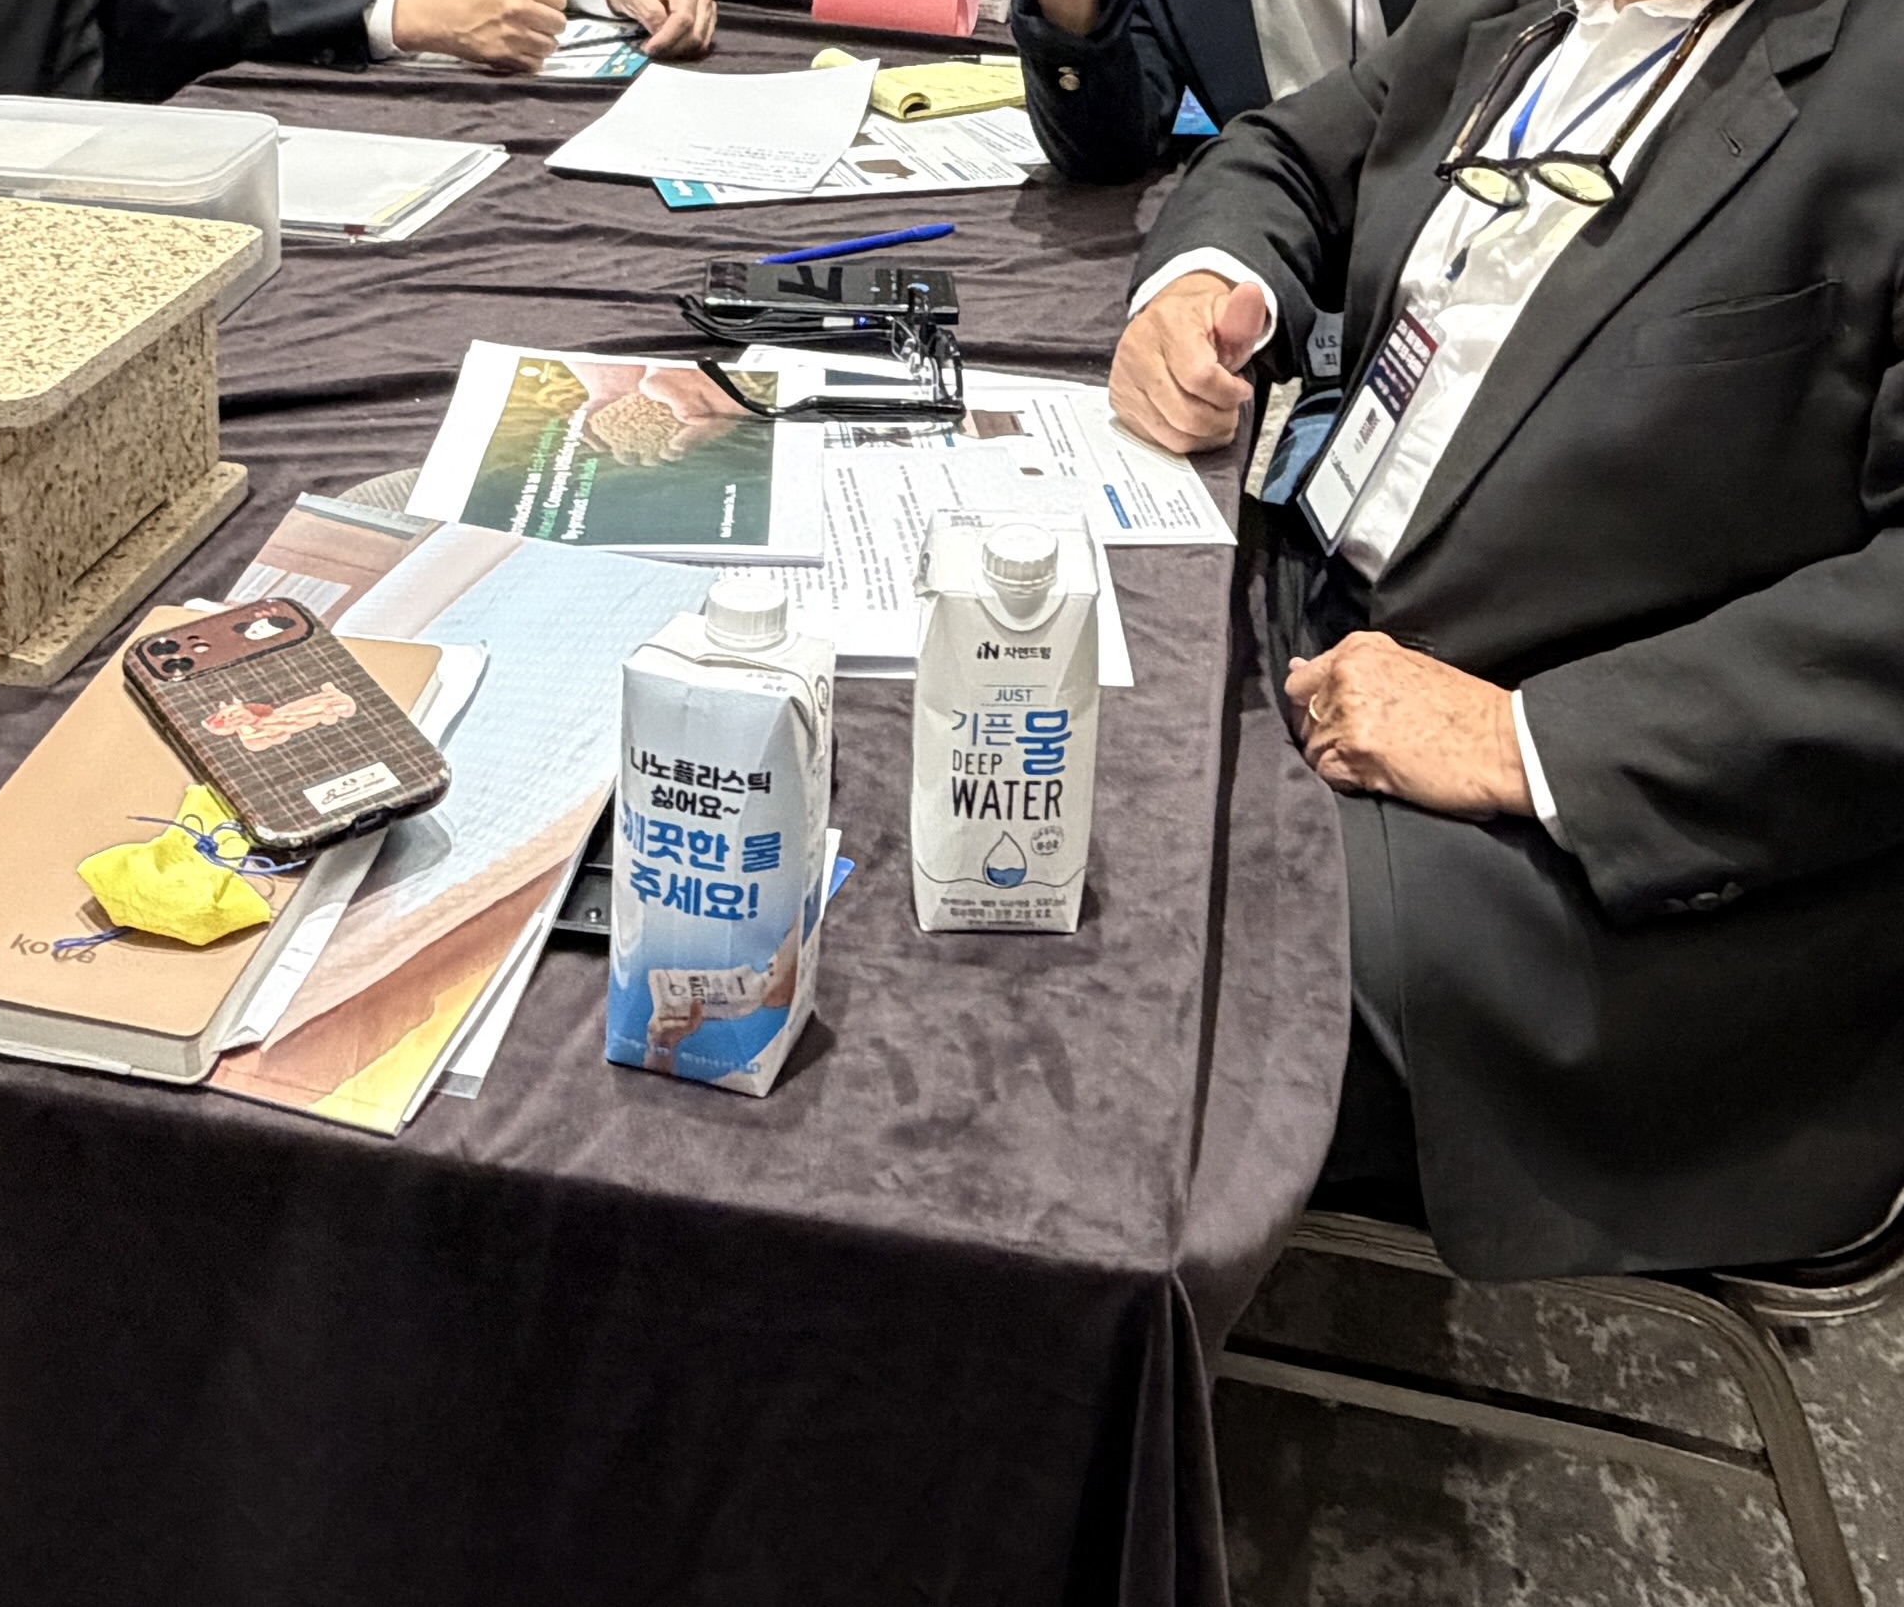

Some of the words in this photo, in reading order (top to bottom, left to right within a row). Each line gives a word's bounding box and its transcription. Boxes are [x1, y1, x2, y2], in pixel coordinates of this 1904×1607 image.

[994, 689, 1034, 702] JUST
[630, 745, 772, 794] 나노플라스틱
[952, 749, 1003, 775] DEEP
[651, 784, 740, 820] 싫어요~
[951, 776, 1063, 821] WATER
[742, 832, 781, 873] 물
[630, 859, 759, 920] 주세요!
